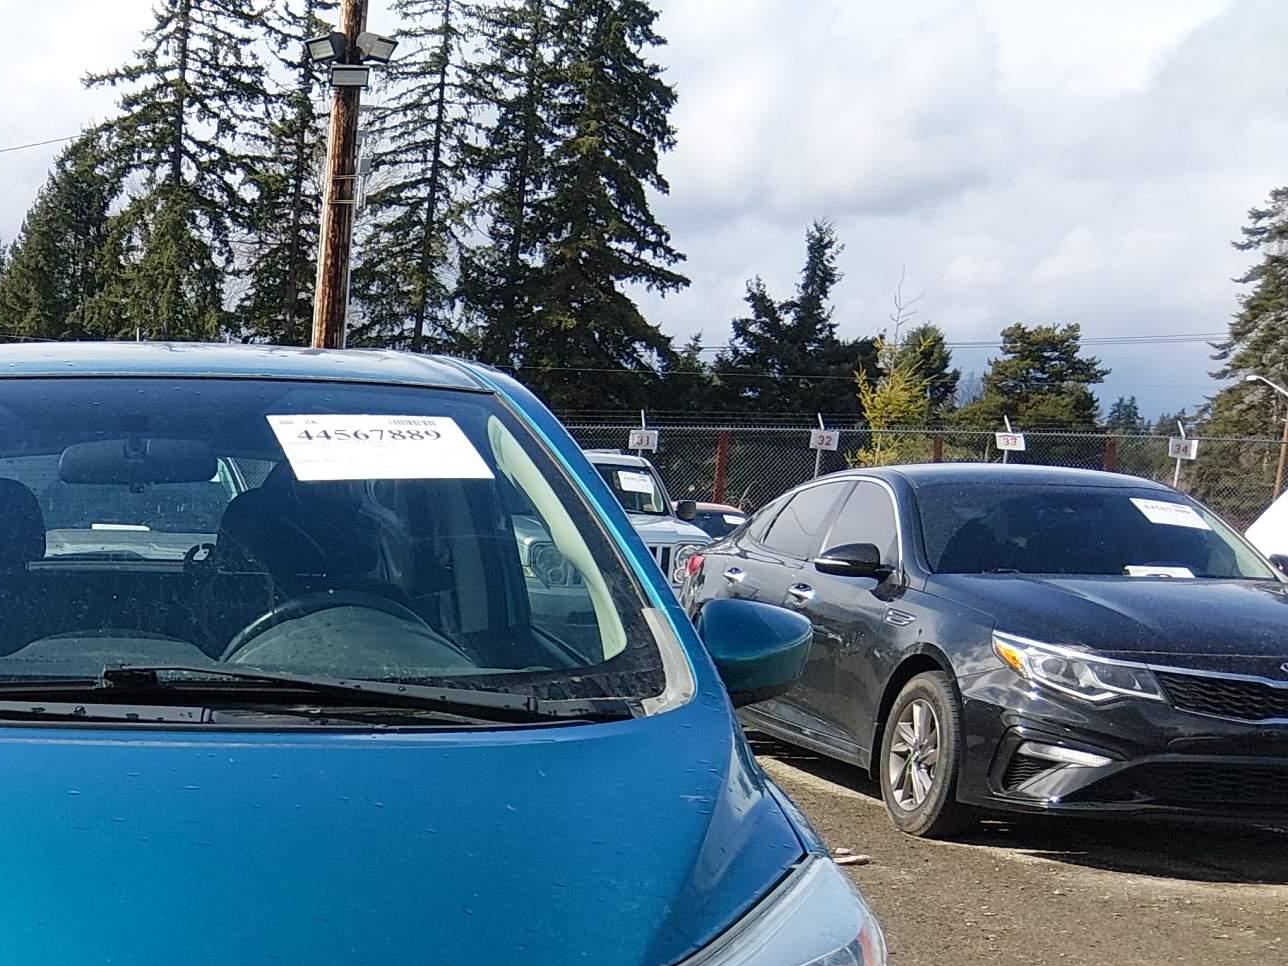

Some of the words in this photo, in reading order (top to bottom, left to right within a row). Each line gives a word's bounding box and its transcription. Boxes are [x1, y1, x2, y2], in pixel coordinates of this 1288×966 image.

[297, 429, 441, 440] 44567889
[637, 435, 650, 445] 31
[817, 435, 832, 446] 32
[1002, 437, 1017, 447] 33
